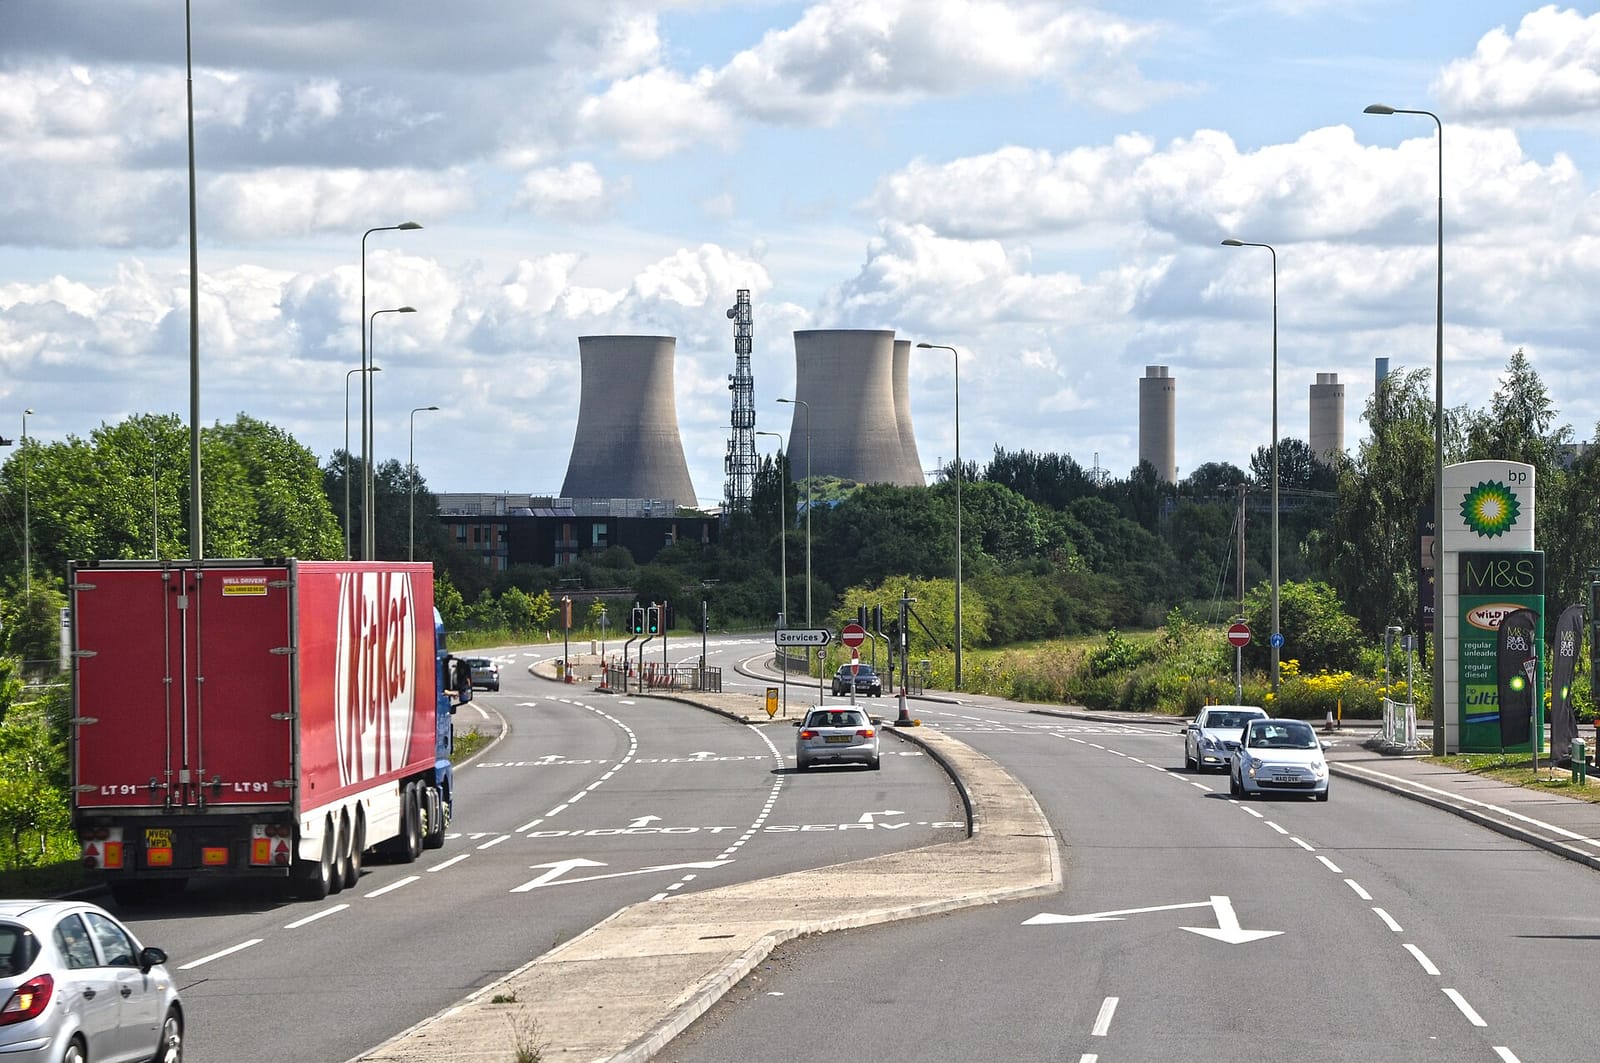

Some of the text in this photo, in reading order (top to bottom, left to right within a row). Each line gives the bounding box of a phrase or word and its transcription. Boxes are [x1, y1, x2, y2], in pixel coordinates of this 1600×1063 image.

[1508, 469, 1527, 485] bp
[1466, 560, 1534, 588] M&S
[780, 633, 818, 641] Services
[1464, 642, 1492, 650] regular
[347, 572, 407, 782] KitKat
[101, 785, 137, 795] LT 91
[234, 782, 268, 792] LT 91
[527, 826, 737, 838] DIDCOT
